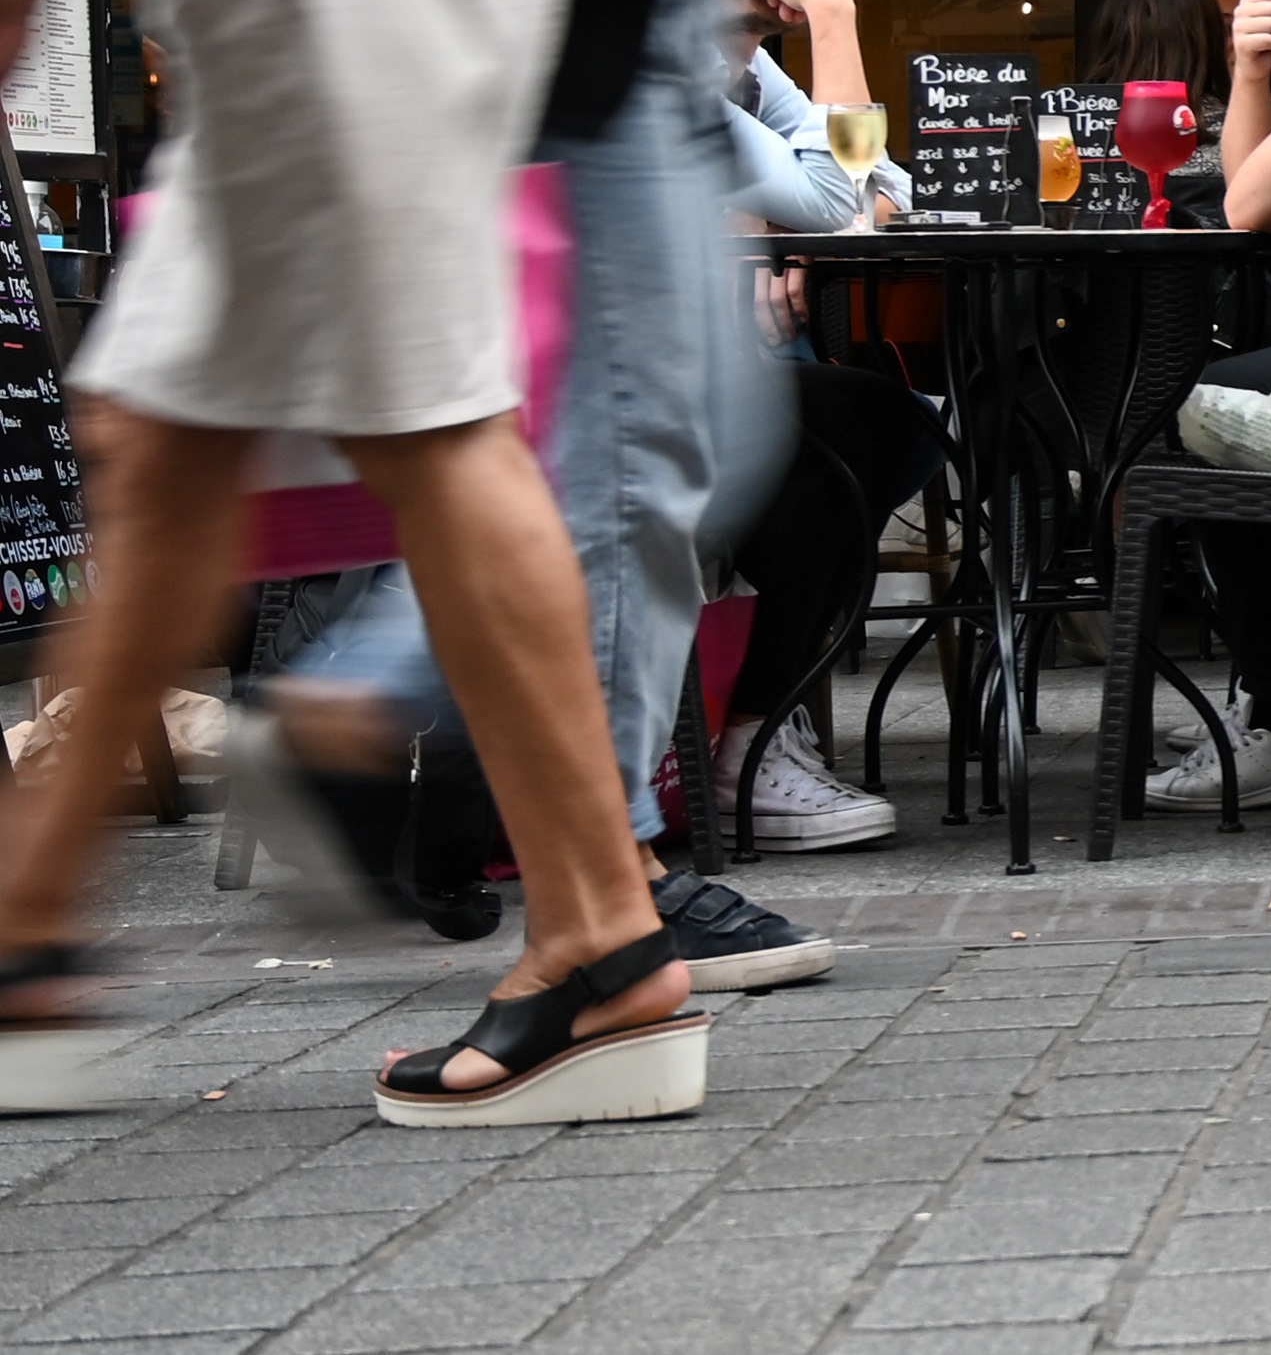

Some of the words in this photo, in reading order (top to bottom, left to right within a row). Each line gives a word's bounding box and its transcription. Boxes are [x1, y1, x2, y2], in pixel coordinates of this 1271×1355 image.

[912, 54, 992, 84] Bière
[997, 62, 1028, 83] du
[928, 86, 971, 114] Mois
[1077, 143, 1105, 157] uvée
[1108, 144, 1122, 157] d
[0, 533, 86, 565] CHISSEZ-VOUS
